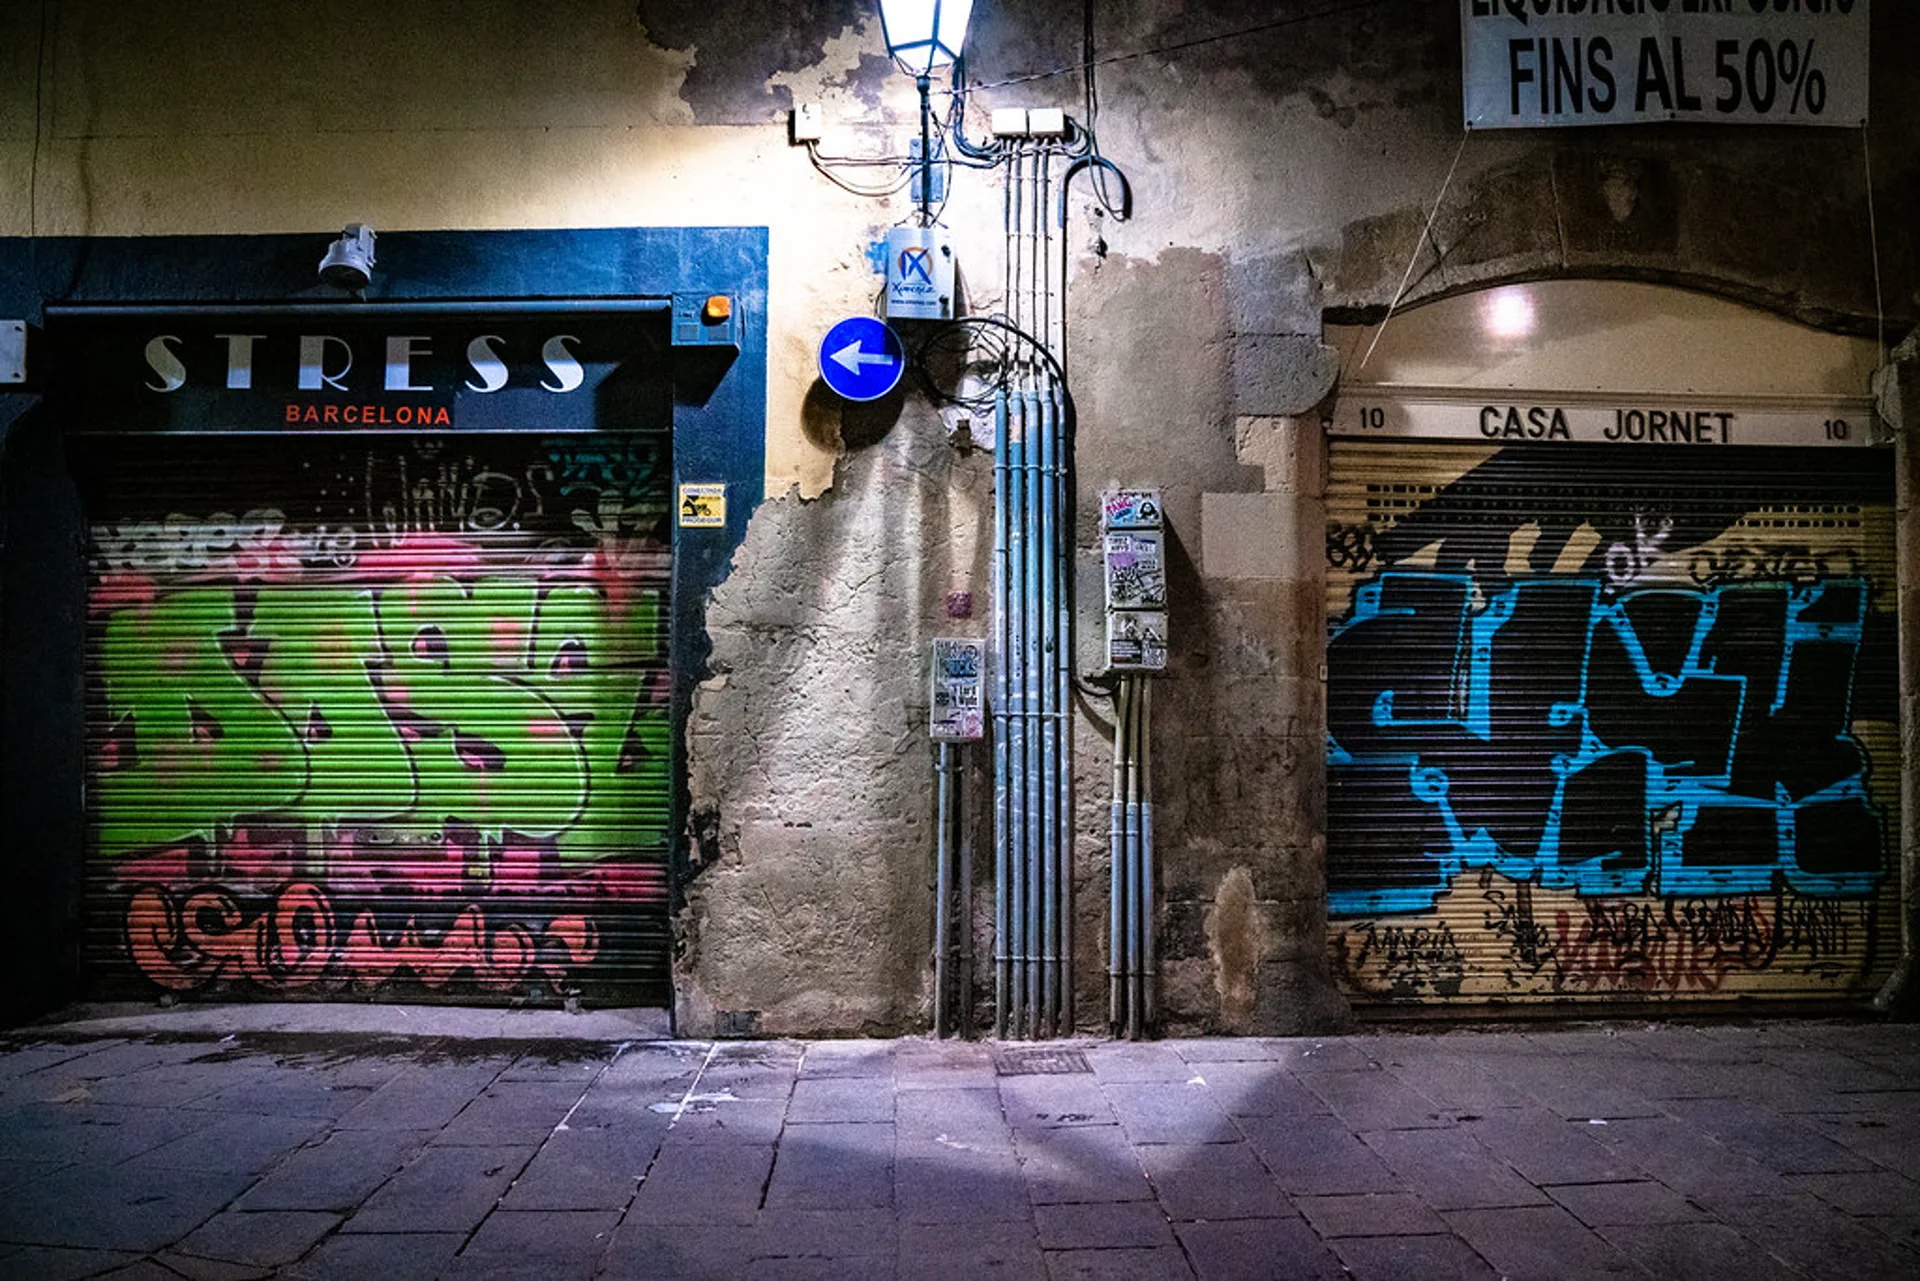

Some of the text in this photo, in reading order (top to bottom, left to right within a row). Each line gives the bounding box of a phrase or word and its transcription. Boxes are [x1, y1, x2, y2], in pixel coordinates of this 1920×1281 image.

[1508, 36, 1826, 115] FINS AL 50%
[144, 334, 586, 394] STRESS
[285, 404, 453, 426] BARCELONA
[1360, 406, 1849, 444] 10 CASA JORNET 10
